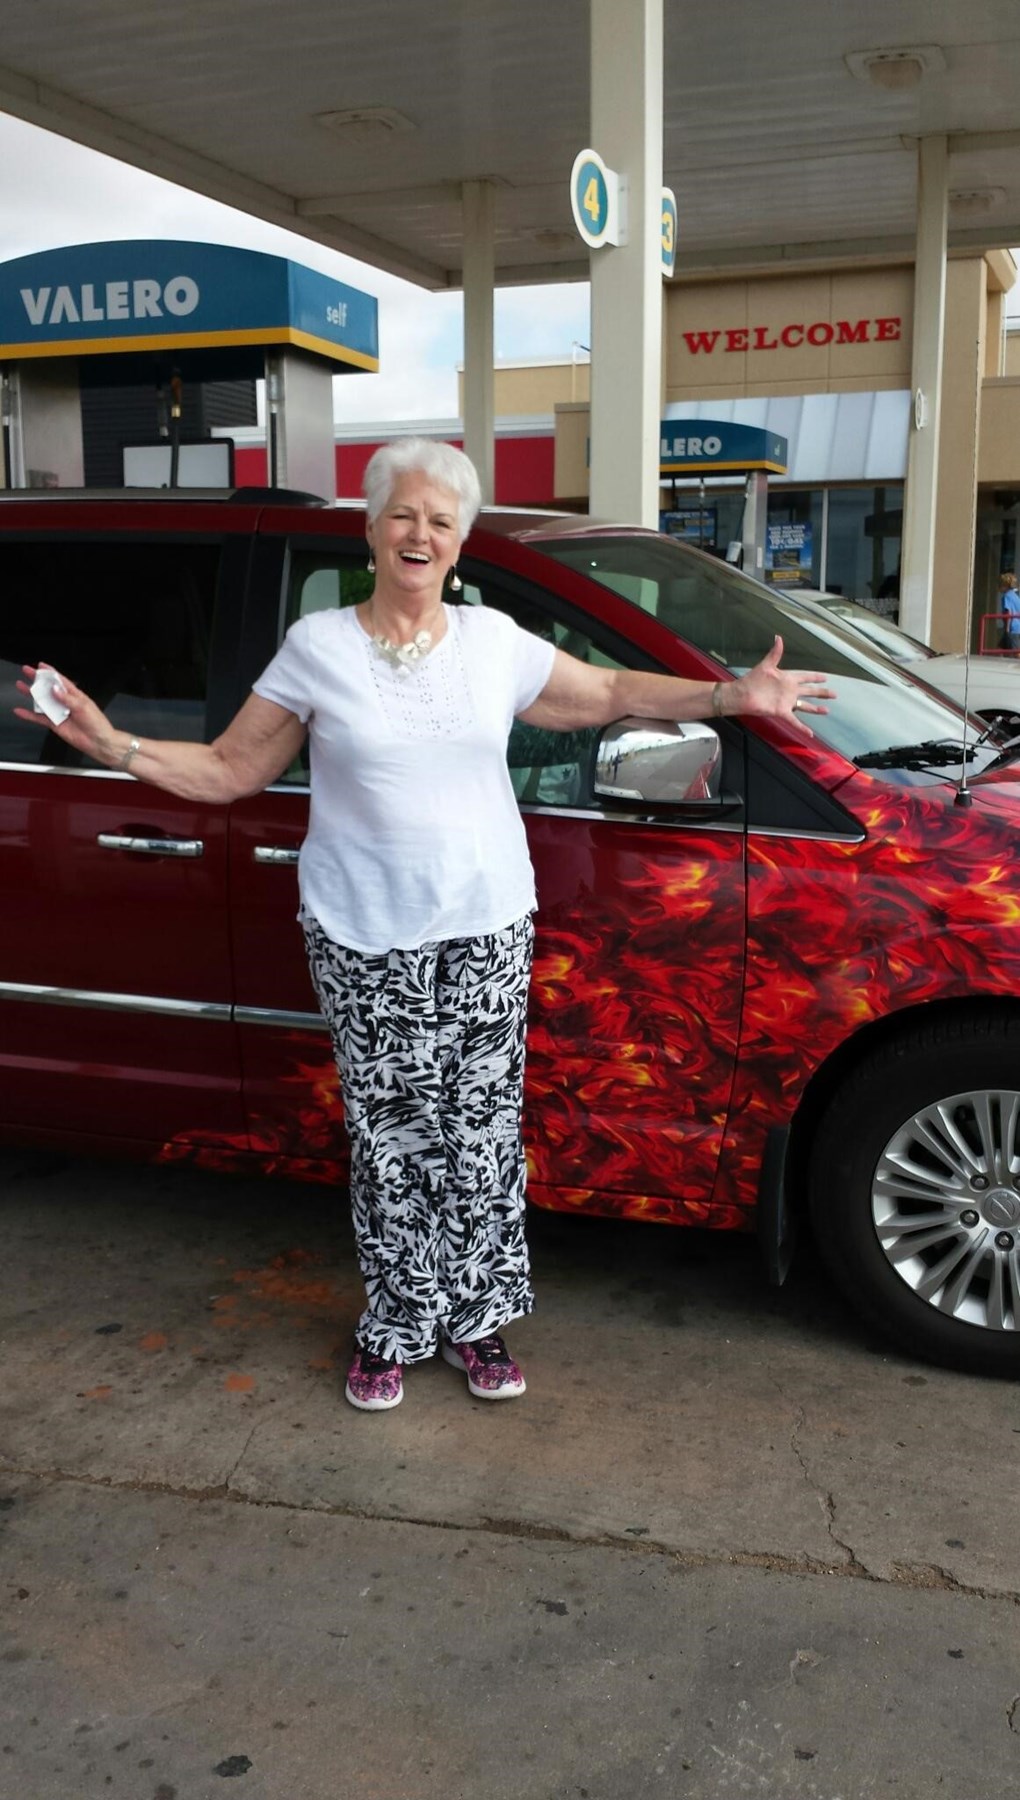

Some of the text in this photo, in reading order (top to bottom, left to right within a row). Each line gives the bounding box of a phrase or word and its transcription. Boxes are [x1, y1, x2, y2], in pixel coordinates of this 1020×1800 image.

[584, 178, 599, 222] 4
[661, 211, 674, 253] 3
[20, 275, 200, 325] VALERO
[326, 301, 347, 328] self
[682, 317, 902, 354] WELCOME
[660, 436, 722, 457] LERO
